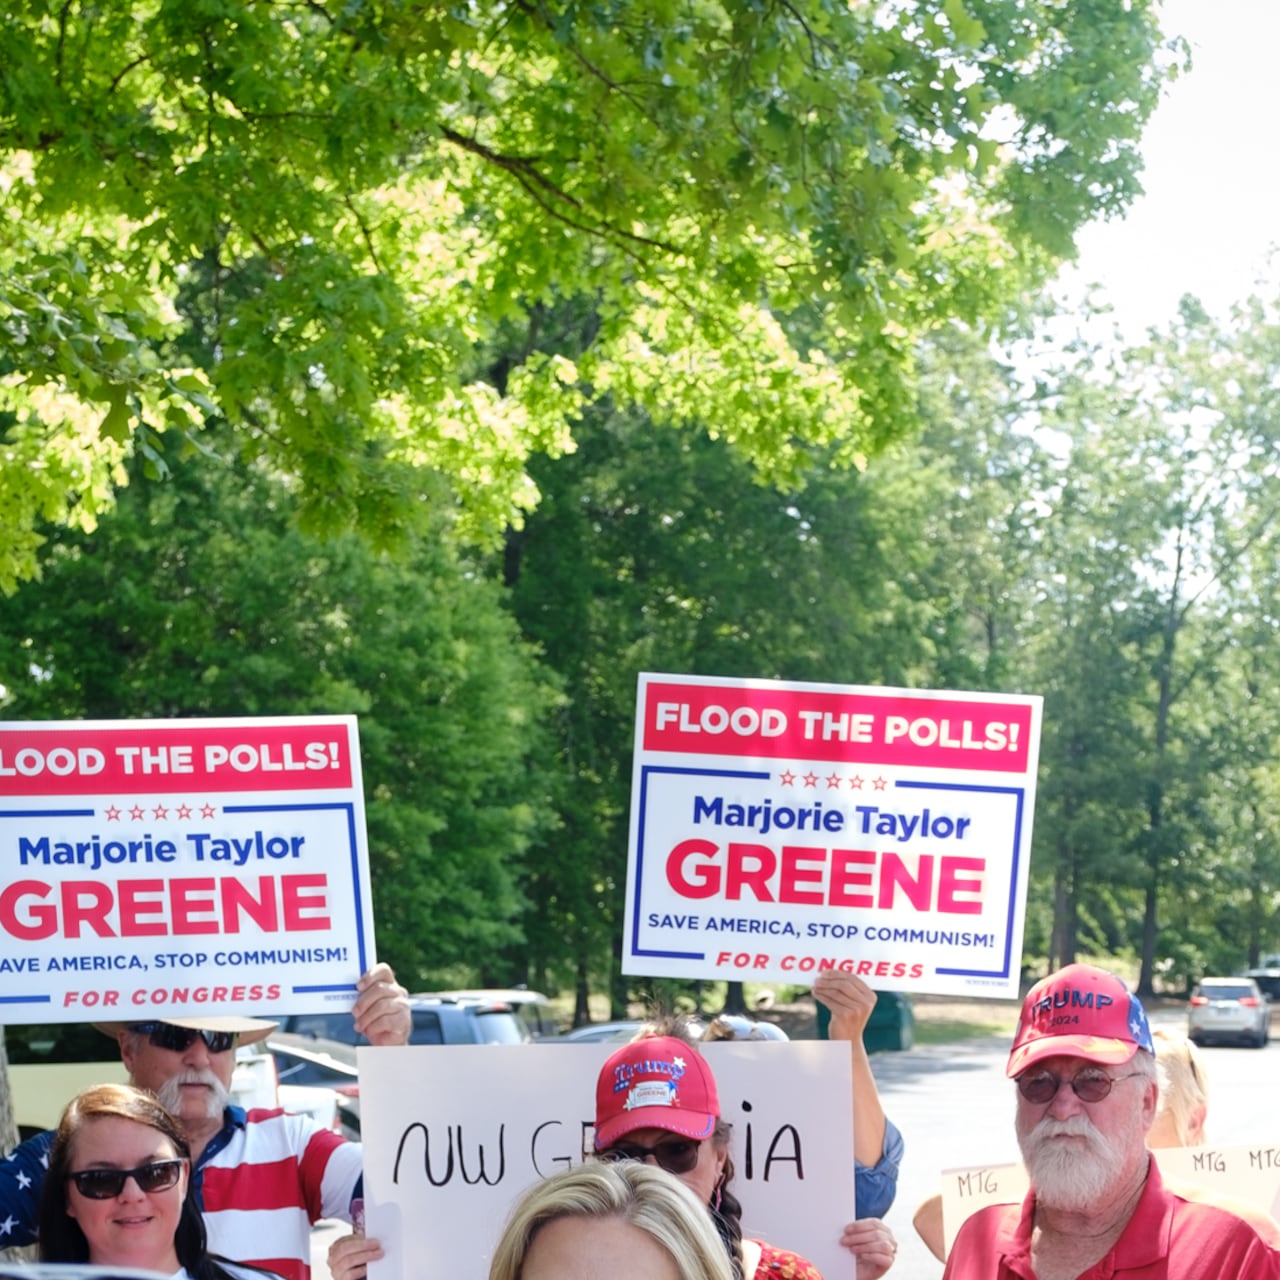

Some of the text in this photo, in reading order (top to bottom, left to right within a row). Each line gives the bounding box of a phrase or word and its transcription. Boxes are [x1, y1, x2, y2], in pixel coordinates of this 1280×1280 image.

[656, 702, 1020, 752] FLOOD THE POLLS!
[115, 746, 194, 775] THE
[204, 742, 340, 773] POLLS!
[693, 795, 971, 842] Marjorie Taylor
[18, 831, 305, 870] Marjorie Taylor
[665, 838, 986, 915] GREENE
[648, 913, 995, 948] SAVE AMERICA, STOP COMMUNISM!
[47, 955, 148, 972] AMERICA,
[154, 953, 208, 969] STOP
[214, 947, 348, 967] COMMUNISM!
[716, 951, 924, 979] FOR CONGRESS
[63, 984, 281, 1007] FOR CONGRESS
[1032, 987, 1114, 1022] TRUMP
[613, 1059, 686, 1084] Trump
[393, 1121, 505, 1187] NW
[958, 1169, 998, 1198] MTG
[1192, 1151, 1227, 1172] MTG
